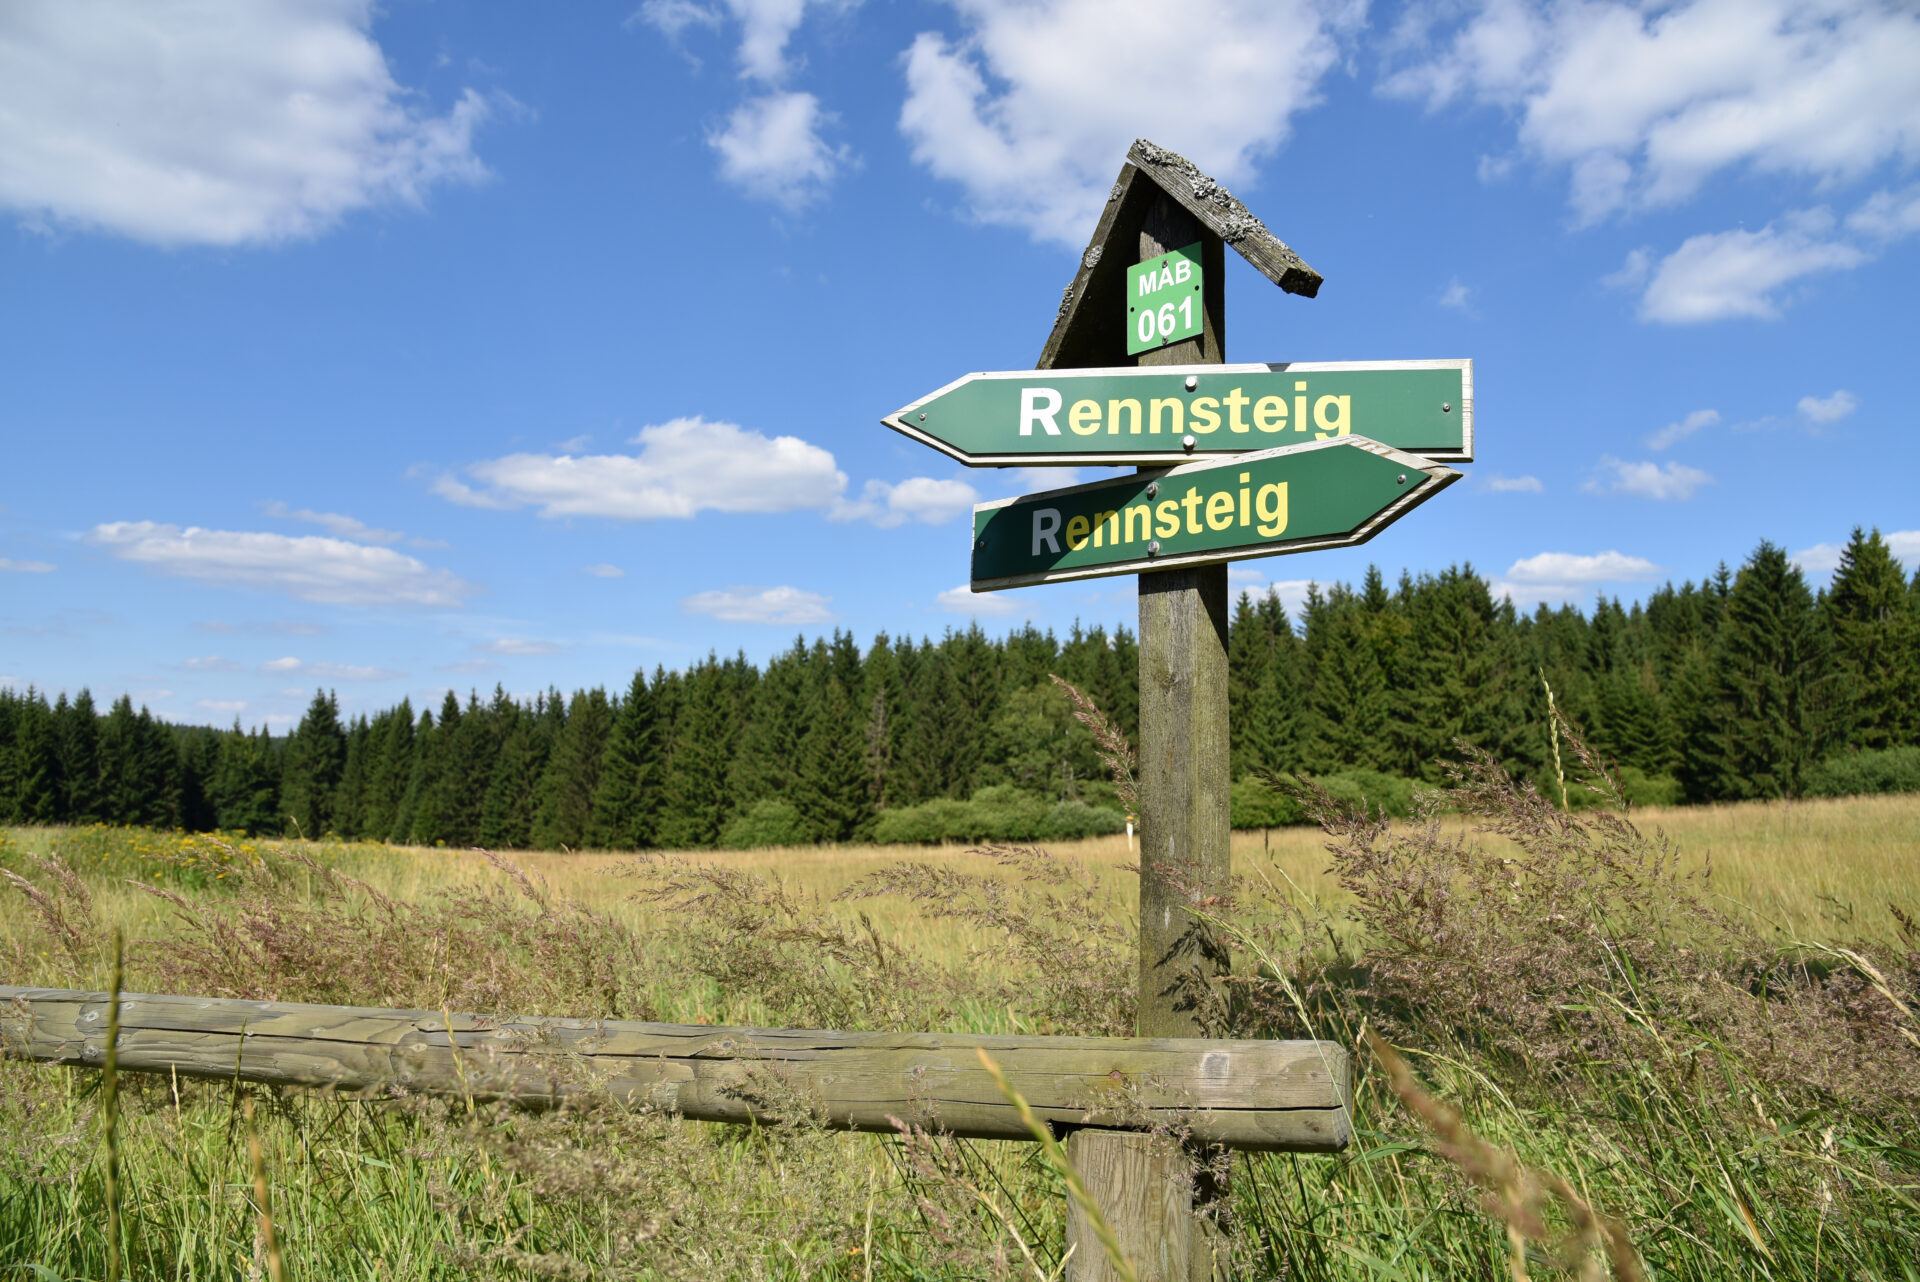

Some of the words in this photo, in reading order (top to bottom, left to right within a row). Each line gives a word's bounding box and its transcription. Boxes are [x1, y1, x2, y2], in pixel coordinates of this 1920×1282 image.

[1139, 259, 1191, 296] MAB
[1138, 296, 1192, 342] 061
[1018, 381, 1351, 440] Rennsteig
[1031, 472, 1288, 556] Rennsteig
